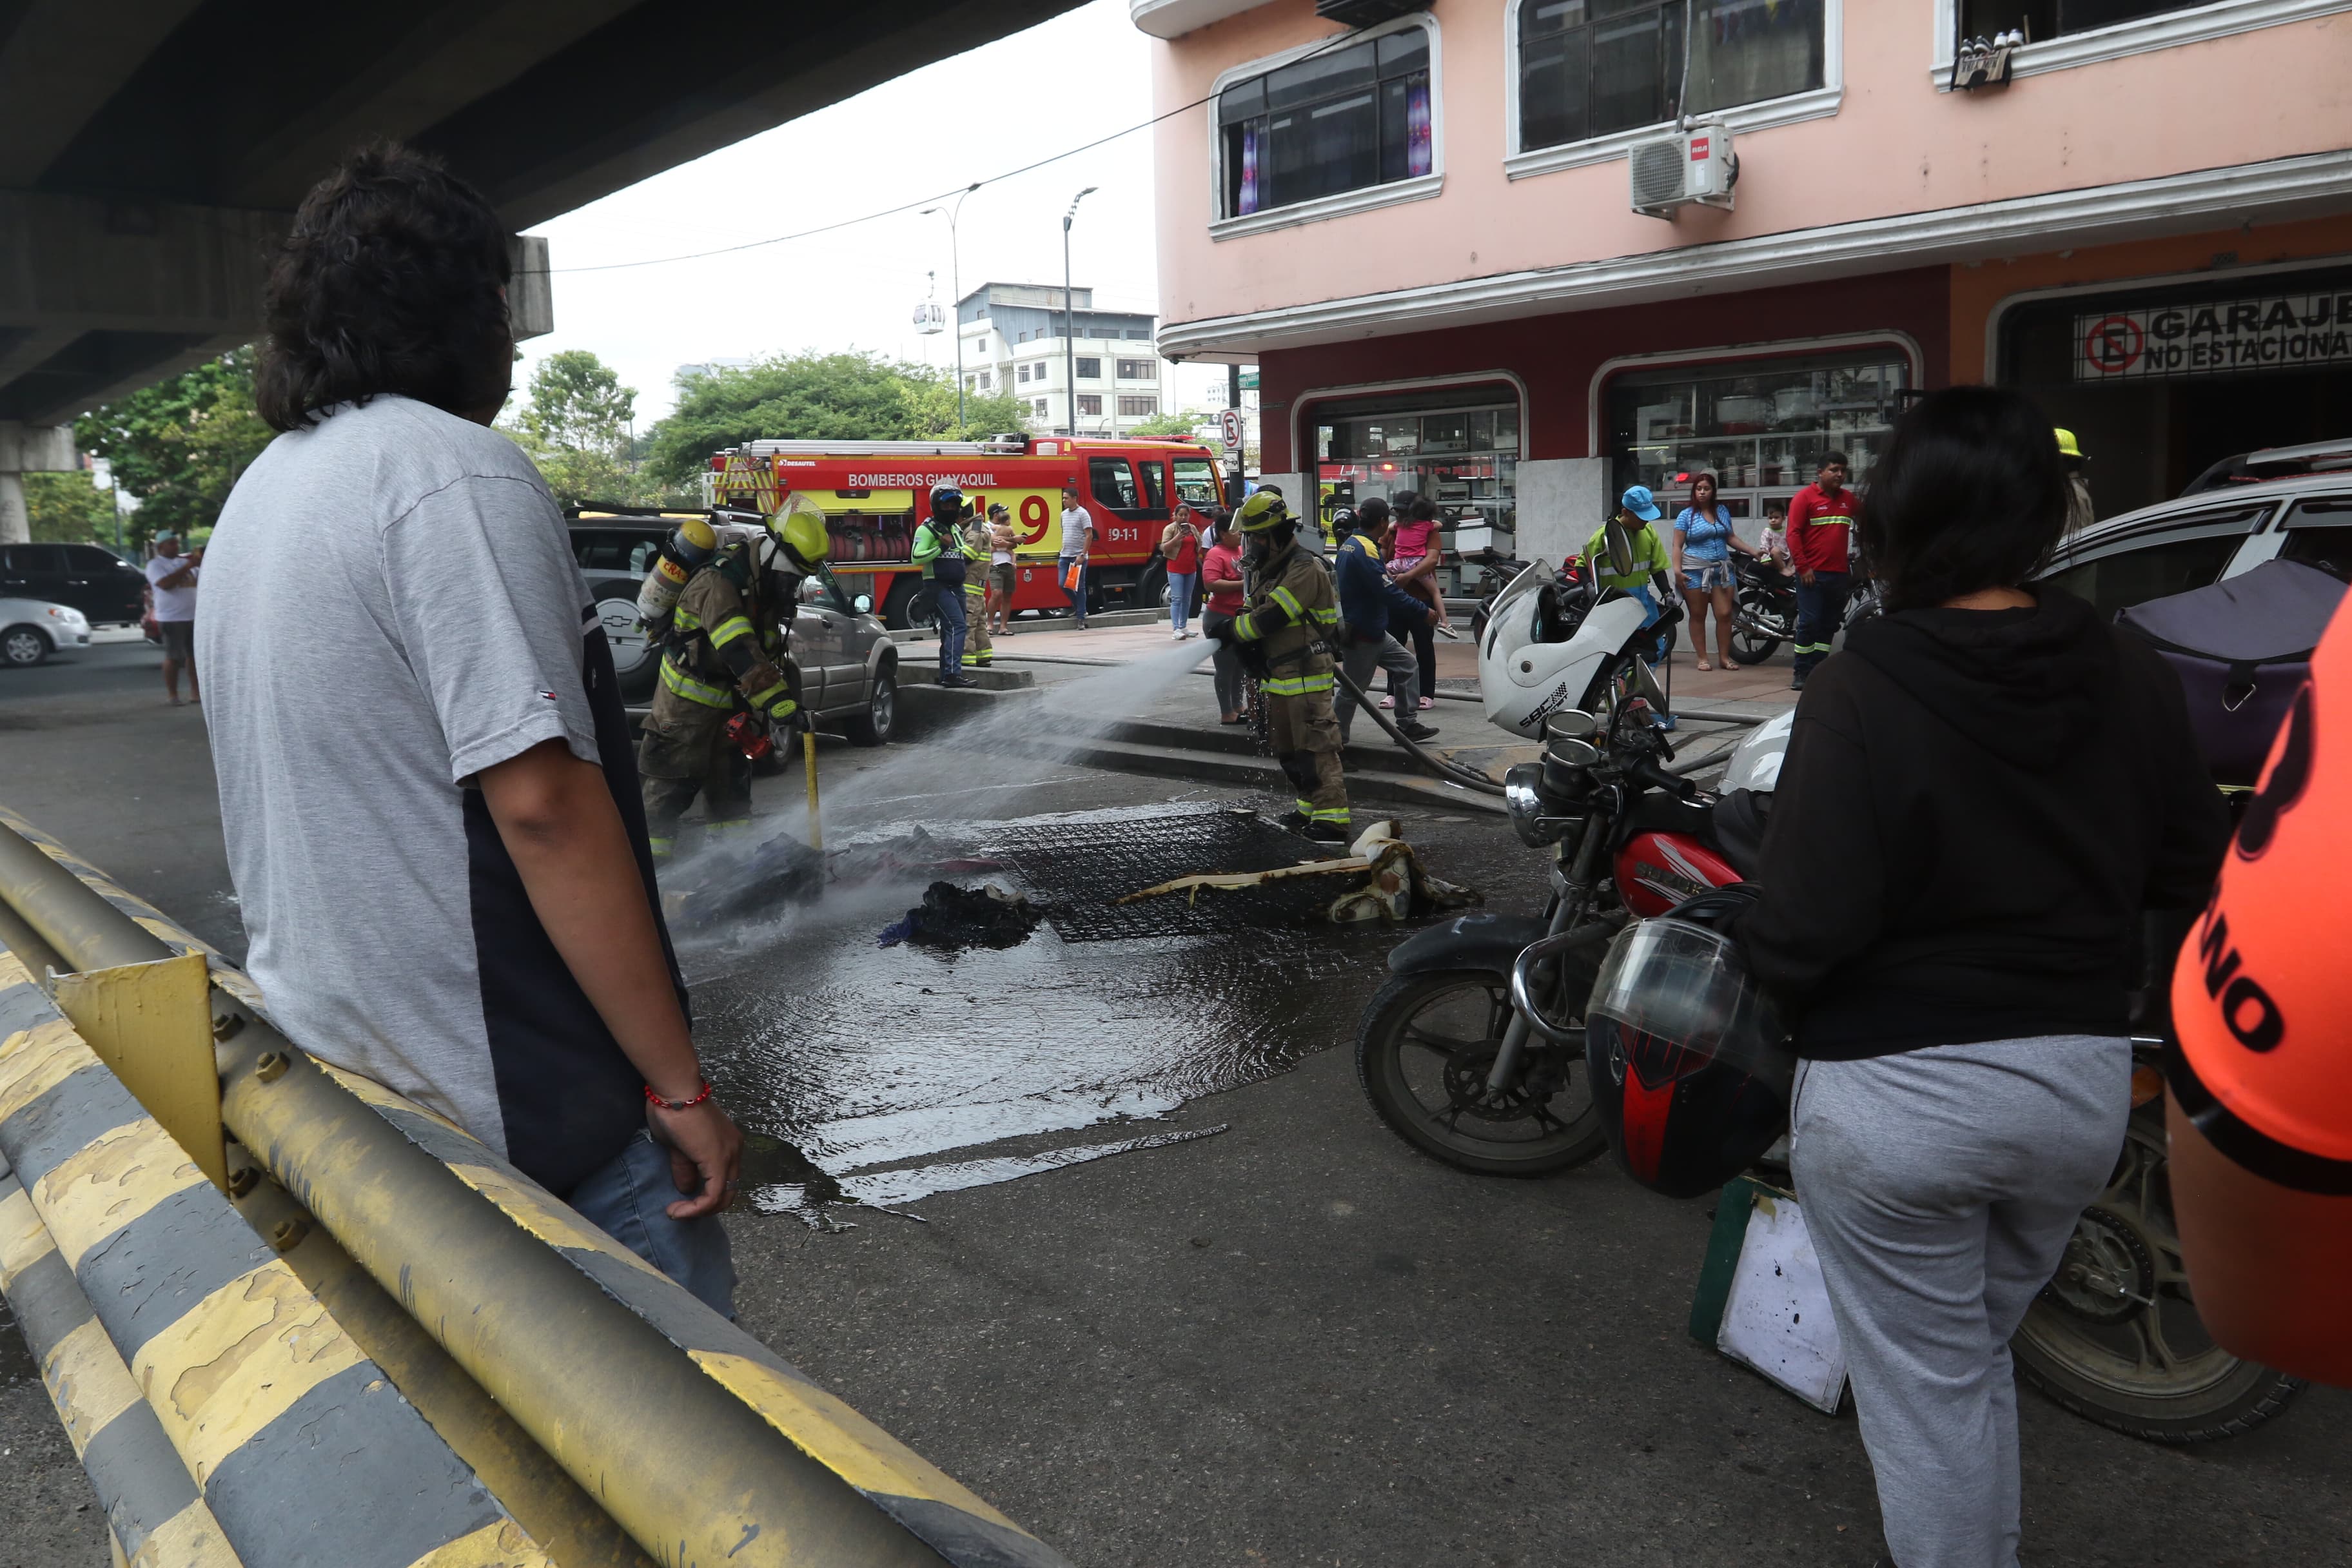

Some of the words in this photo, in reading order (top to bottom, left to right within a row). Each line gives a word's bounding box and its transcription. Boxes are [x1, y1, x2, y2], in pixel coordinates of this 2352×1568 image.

[1692, 145, 1707, 153] RCA
[2151, 295, 2352, 340] GARAJE
[2146, 345, 2182, 369] NO
[848, 474, 923, 487] BOMBEROS
[1112, 527, 1137, 541] 9-1-1
[1519, 697, 1553, 727] SBC
[1635, 862, 1705, 896] SUZUK
[2199, 870, 2284, 1054] NO
